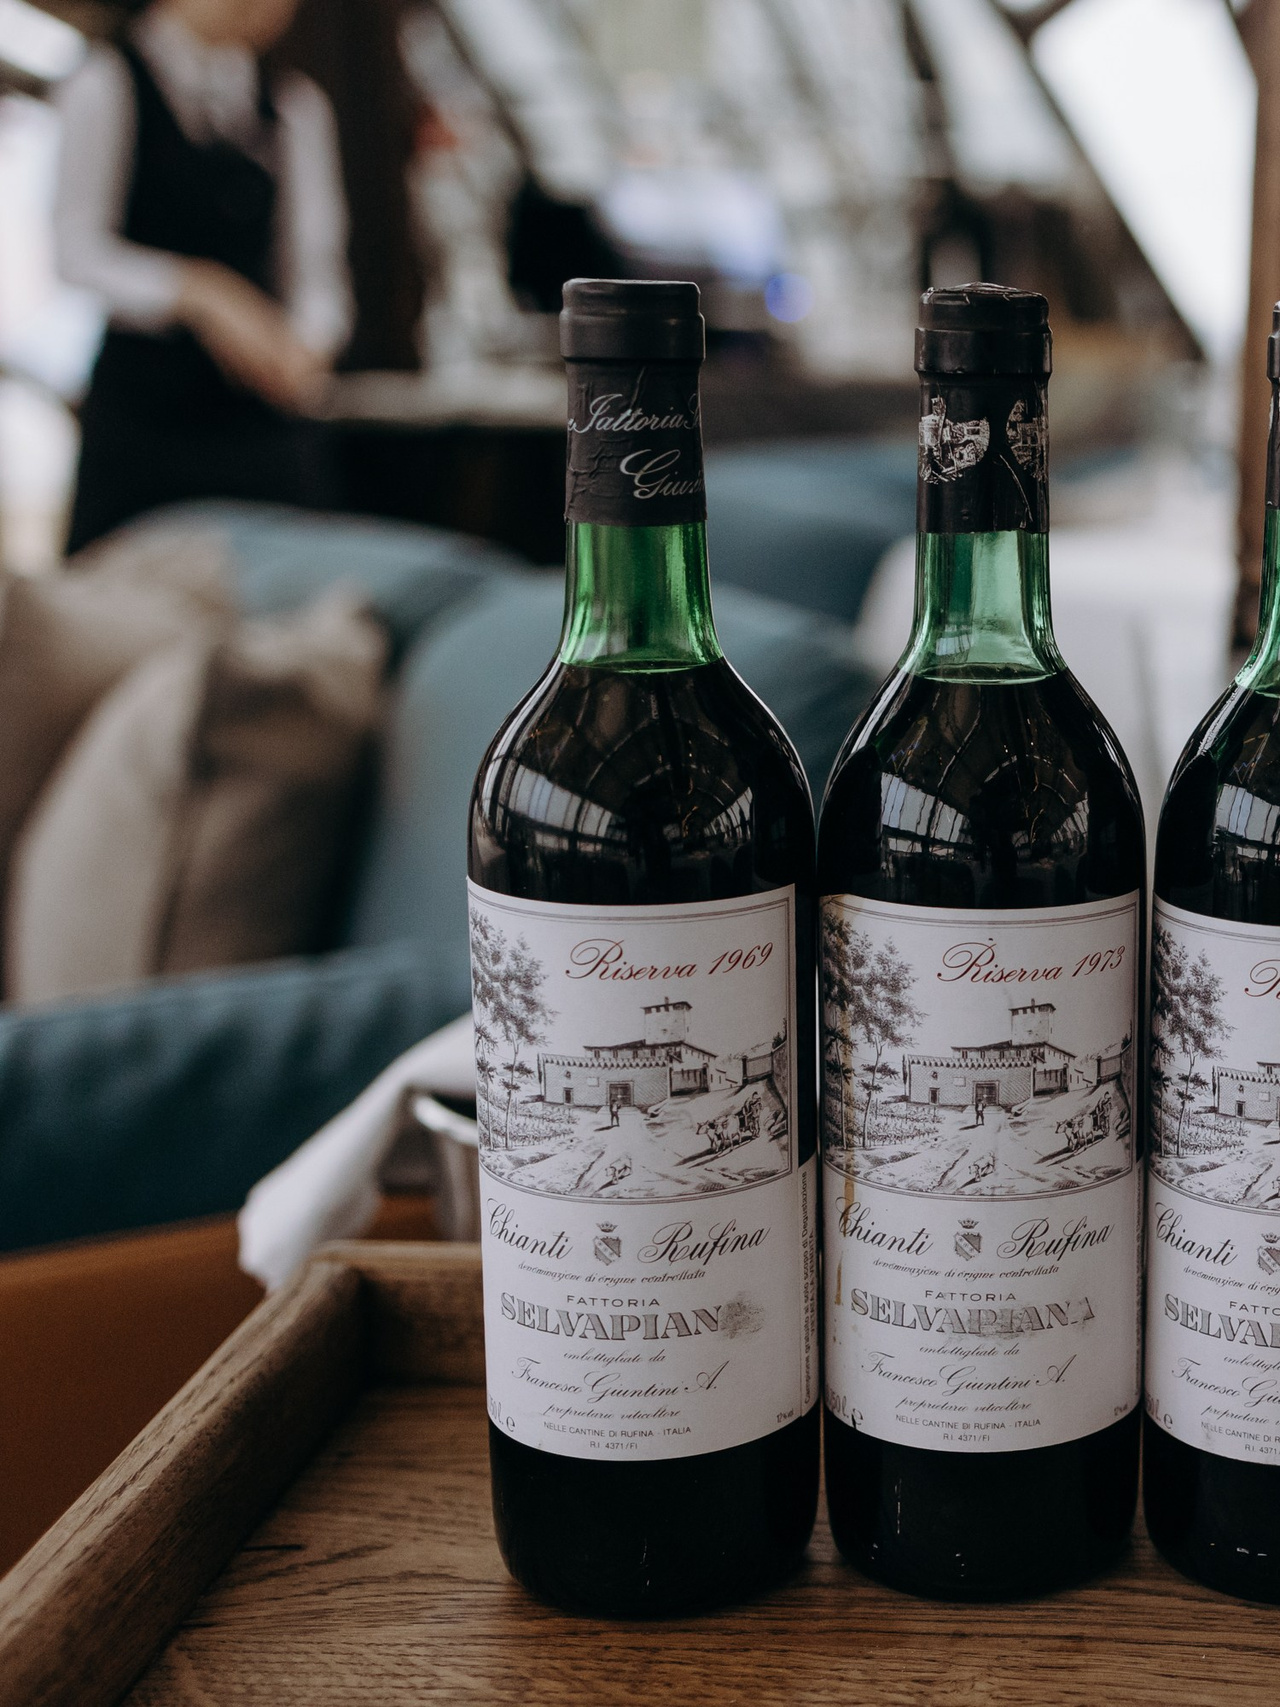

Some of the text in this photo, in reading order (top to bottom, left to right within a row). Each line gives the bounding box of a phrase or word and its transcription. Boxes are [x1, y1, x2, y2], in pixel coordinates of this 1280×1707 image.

[565, 938, 774, 981] Riserva 1969
[936, 941, 1126, 984] Riserva 1973
[487, 1197, 771, 1267] Chianti Rufina
[835, 1196, 1115, 1262] Chianti Rufina
[1154, 1202, 1240, 1267] Chianti
[518, 1261, 706, 1288] denominazione di origine controllata
[872, 1258, 1060, 1283] denominazione di origine controllata
[1183, 1265, 1246, 1289] denominazione
[1248, 1279, 1258, 1291] di
[566, 1295, 661, 1308] FATTORIA
[925, 1290, 1017, 1302] FATTORIA
[500, 1291, 753, 1341] SELVAPIAN
[649, 1348, 666, 1363] da
[1003, 1342, 1020, 1356] da
[511, 1356, 583, 1393] Francesco
[583, 1370, 680, 1404] Giuntini
[861, 1351, 938, 1388] Francesco
[939, 1364, 1030, 1397] Giuntini
[1171, 1357, 1241, 1398] Francesco
[543, 1421, 567, 1433] NELLE
[569, 1426, 605, 1438] CANTINE
[608, 1430, 617, 1438] DI
[620, 1430, 654, 1438] RUFINA
[663, 1426, 692, 1436] ITALIA
[895, 1414, 920, 1426] NELLE
[922, 1418, 959, 1430] CANTINE
[962, 1422, 971, 1430] DI
[973, 1422, 1006, 1430] RUFINA
[1014, 1418, 1041, 1428] ITALIA
[1200, 1421, 1223, 1434] NELLE
[1225, 1428, 1261, 1442] CANTINE
[1263, 1434, 1272, 1442] DI
